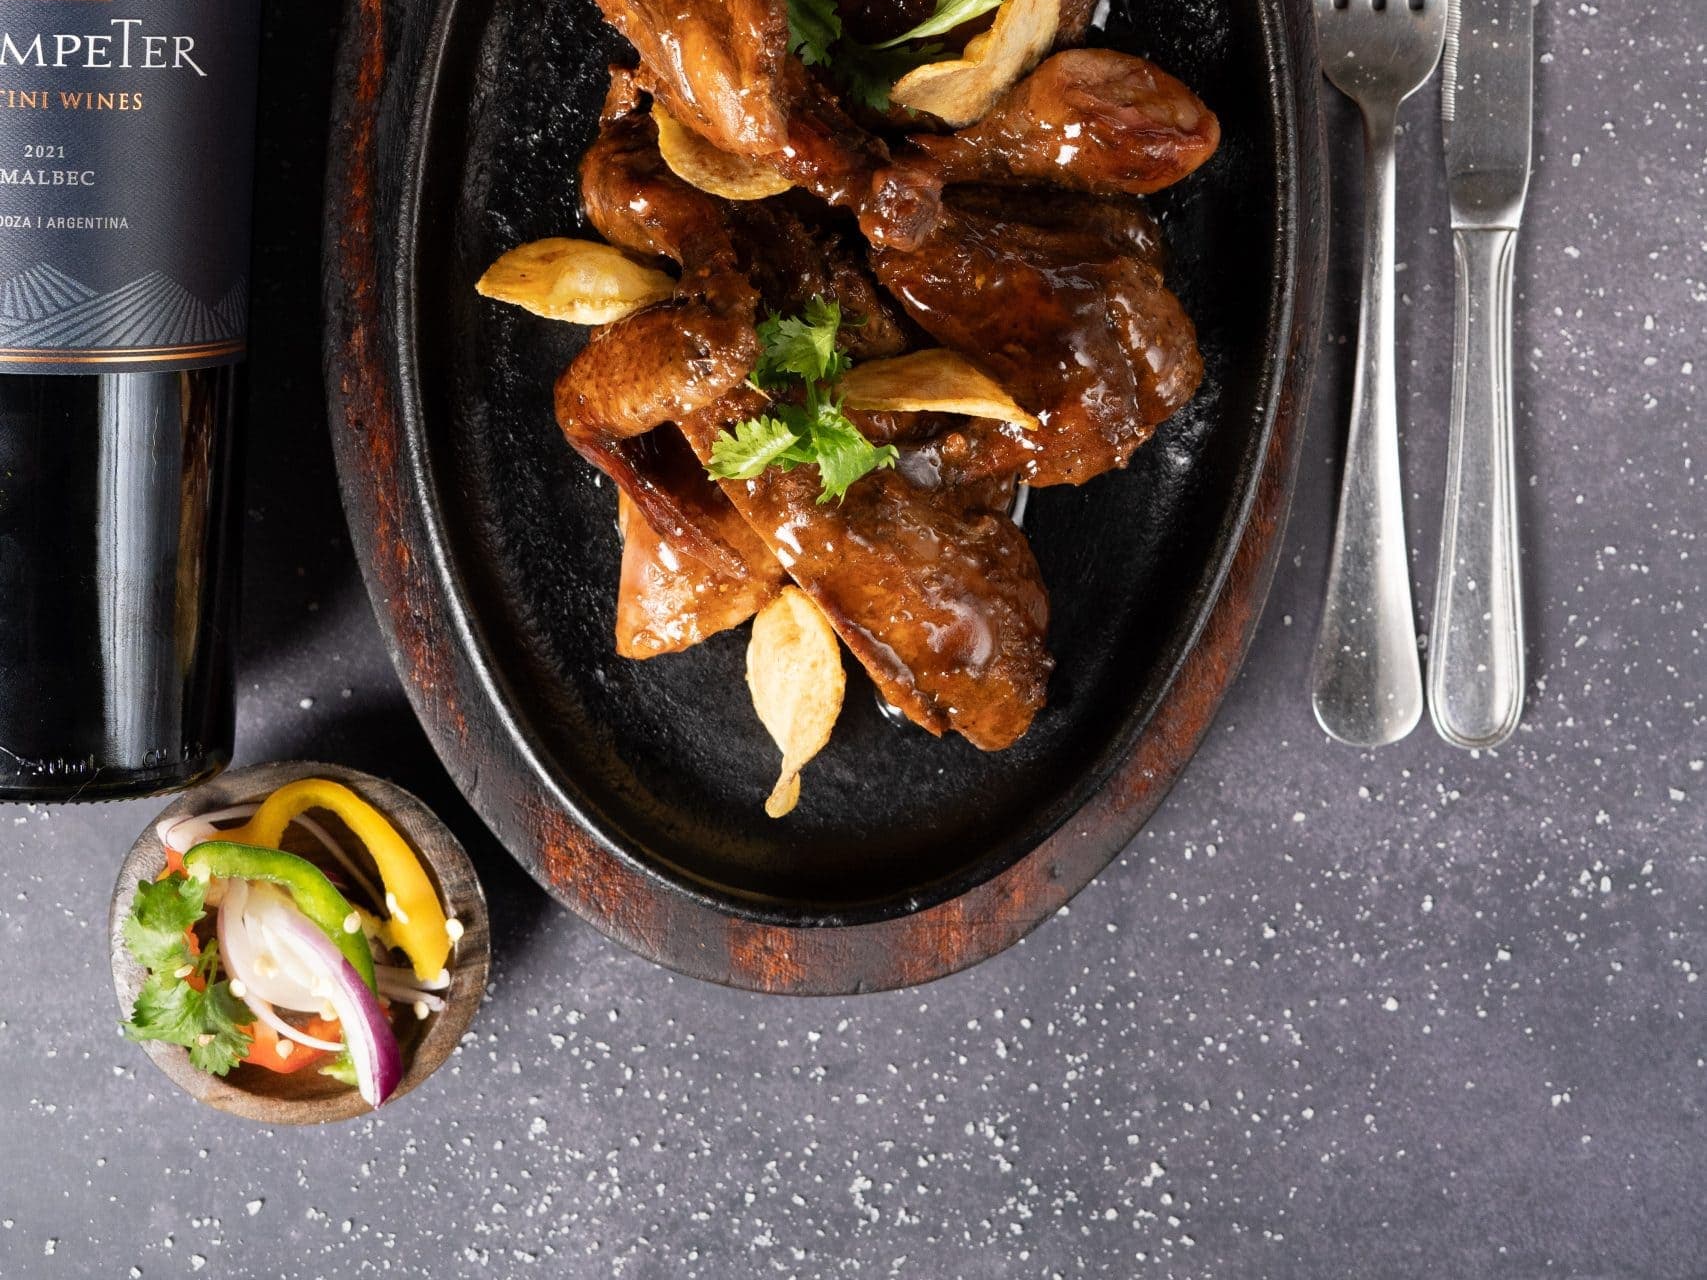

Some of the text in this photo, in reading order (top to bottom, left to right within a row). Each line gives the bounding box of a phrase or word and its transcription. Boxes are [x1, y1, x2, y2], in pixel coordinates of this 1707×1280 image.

[60, 89, 143, 111] WINES
[23, 144, 65, 159] 2021
[0, 168, 95, 187] MALBEC
[46, 217, 129, 230] ARGENTINA
